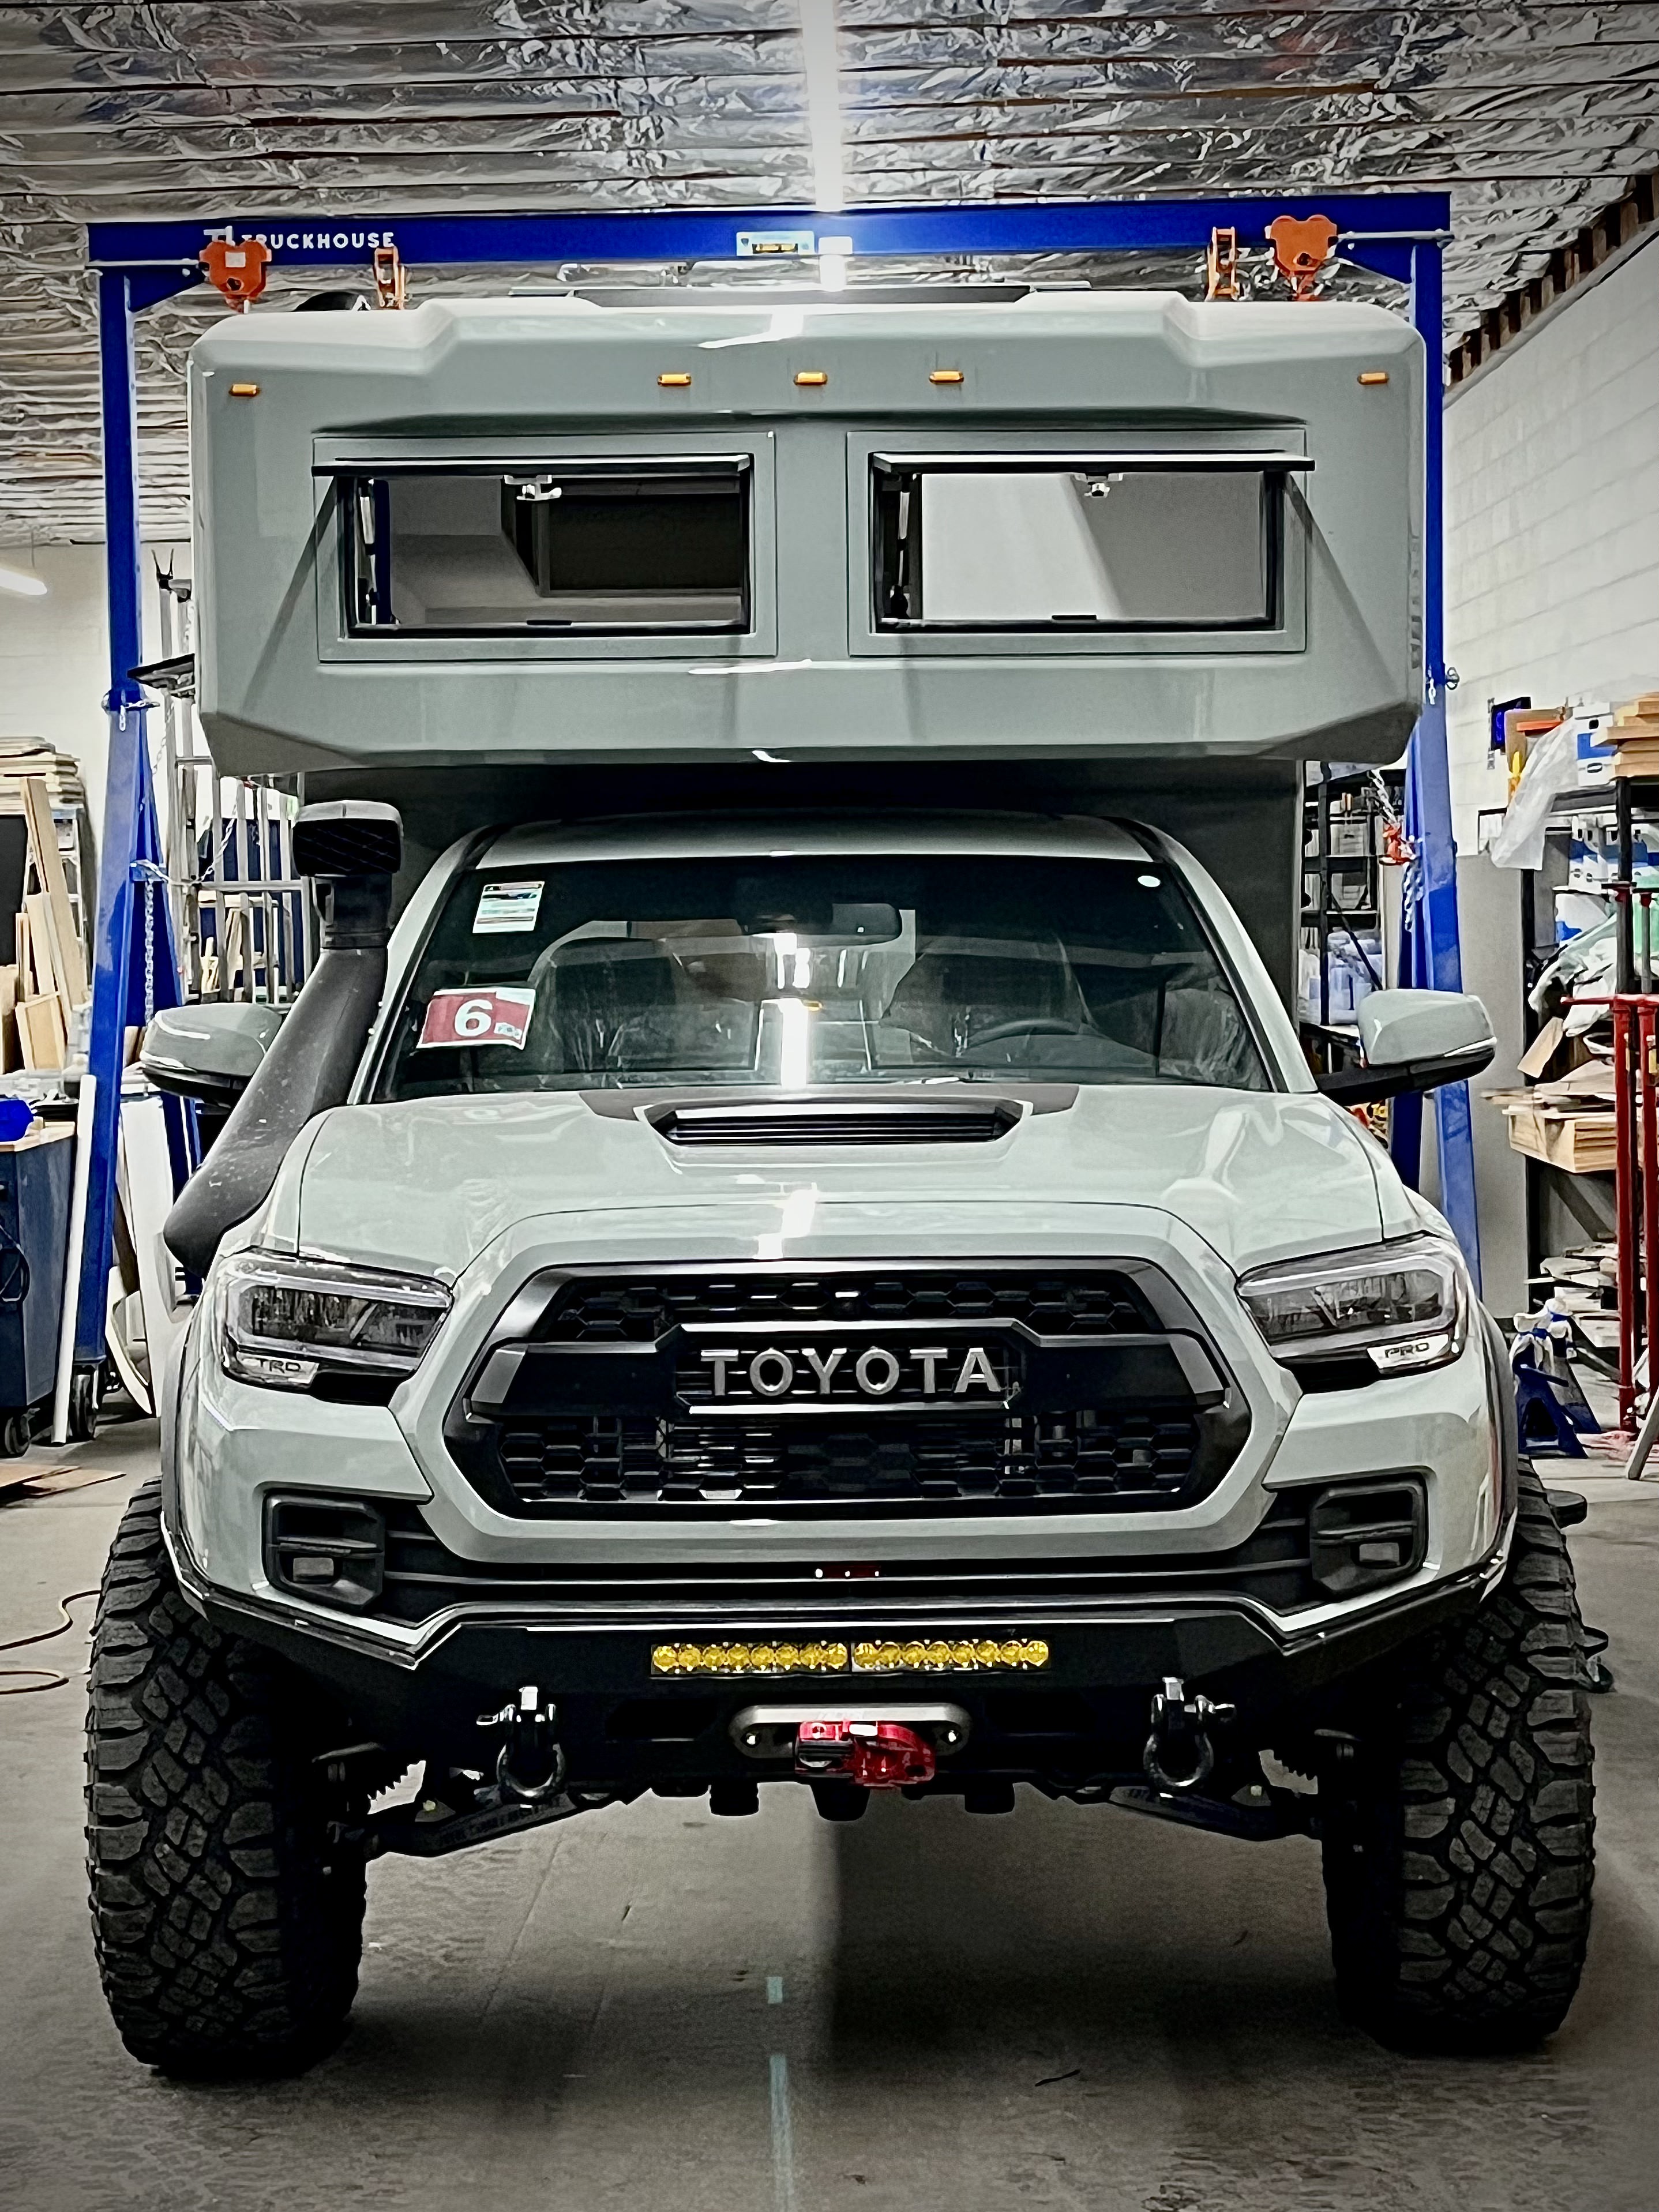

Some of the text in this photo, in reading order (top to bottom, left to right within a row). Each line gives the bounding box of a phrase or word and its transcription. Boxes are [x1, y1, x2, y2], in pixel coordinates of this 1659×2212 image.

[454, 998, 493, 1036] 6
[1384, 1342, 1430, 1358] PRO
[248, 1357, 301, 1374] TRD
[700, 1347, 1001, 1396] TOYOTA
